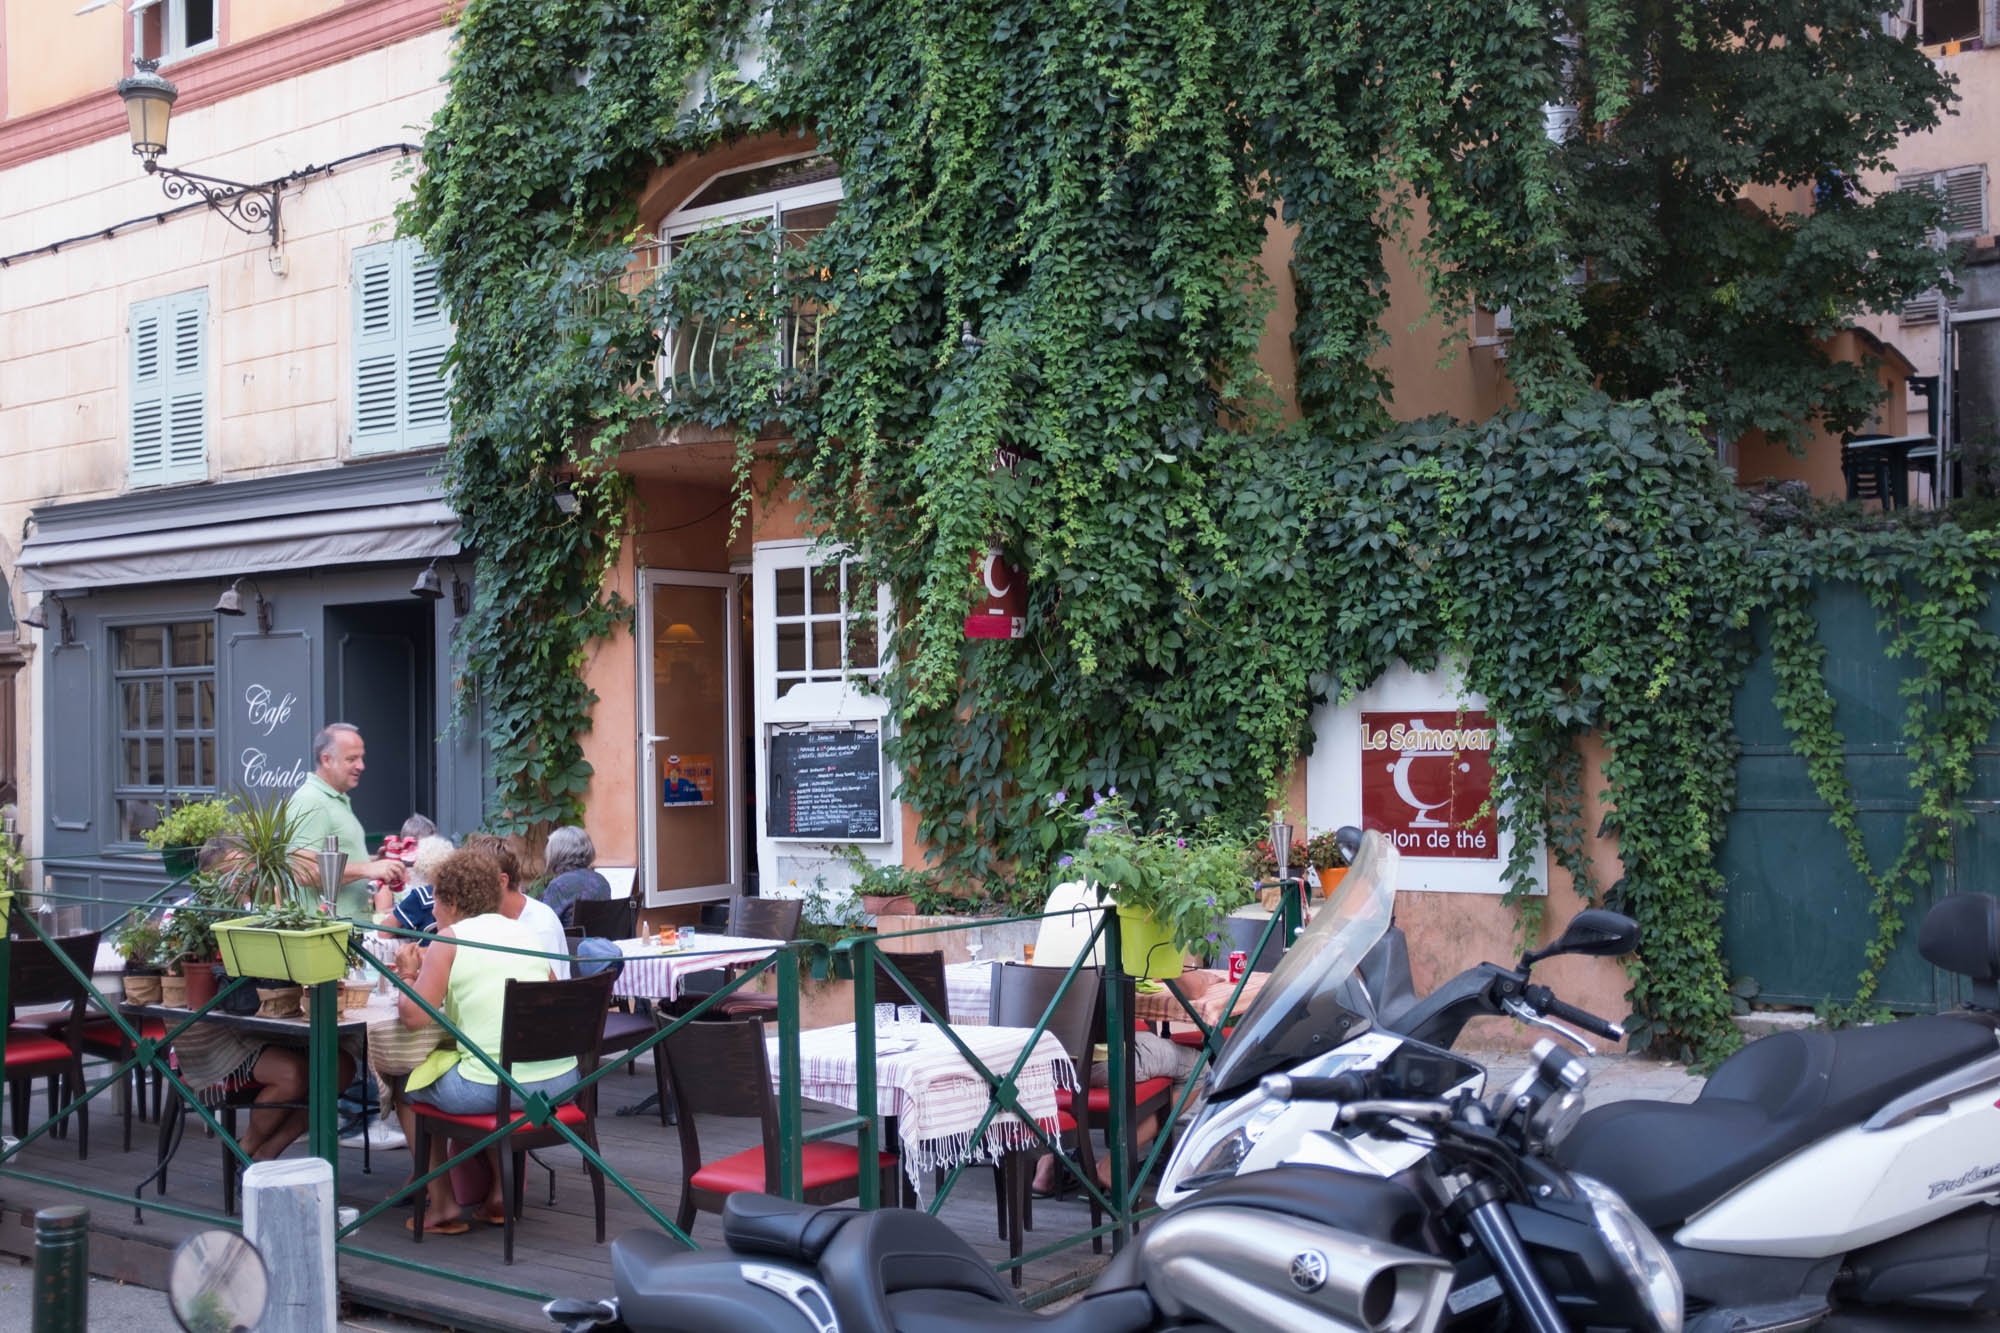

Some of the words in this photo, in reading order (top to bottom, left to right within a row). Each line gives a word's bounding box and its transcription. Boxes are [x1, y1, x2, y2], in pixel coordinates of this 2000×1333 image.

[245, 683, 297, 737] Café
[1361, 723, 1388, 750] Le
[1389, 722, 1494, 751] Samovar
[240, 747, 306, 788] Casale
[1383, 828, 1421, 848] alon
[1426, 829, 1450, 848] de
[1456, 830, 1487, 849] thé
